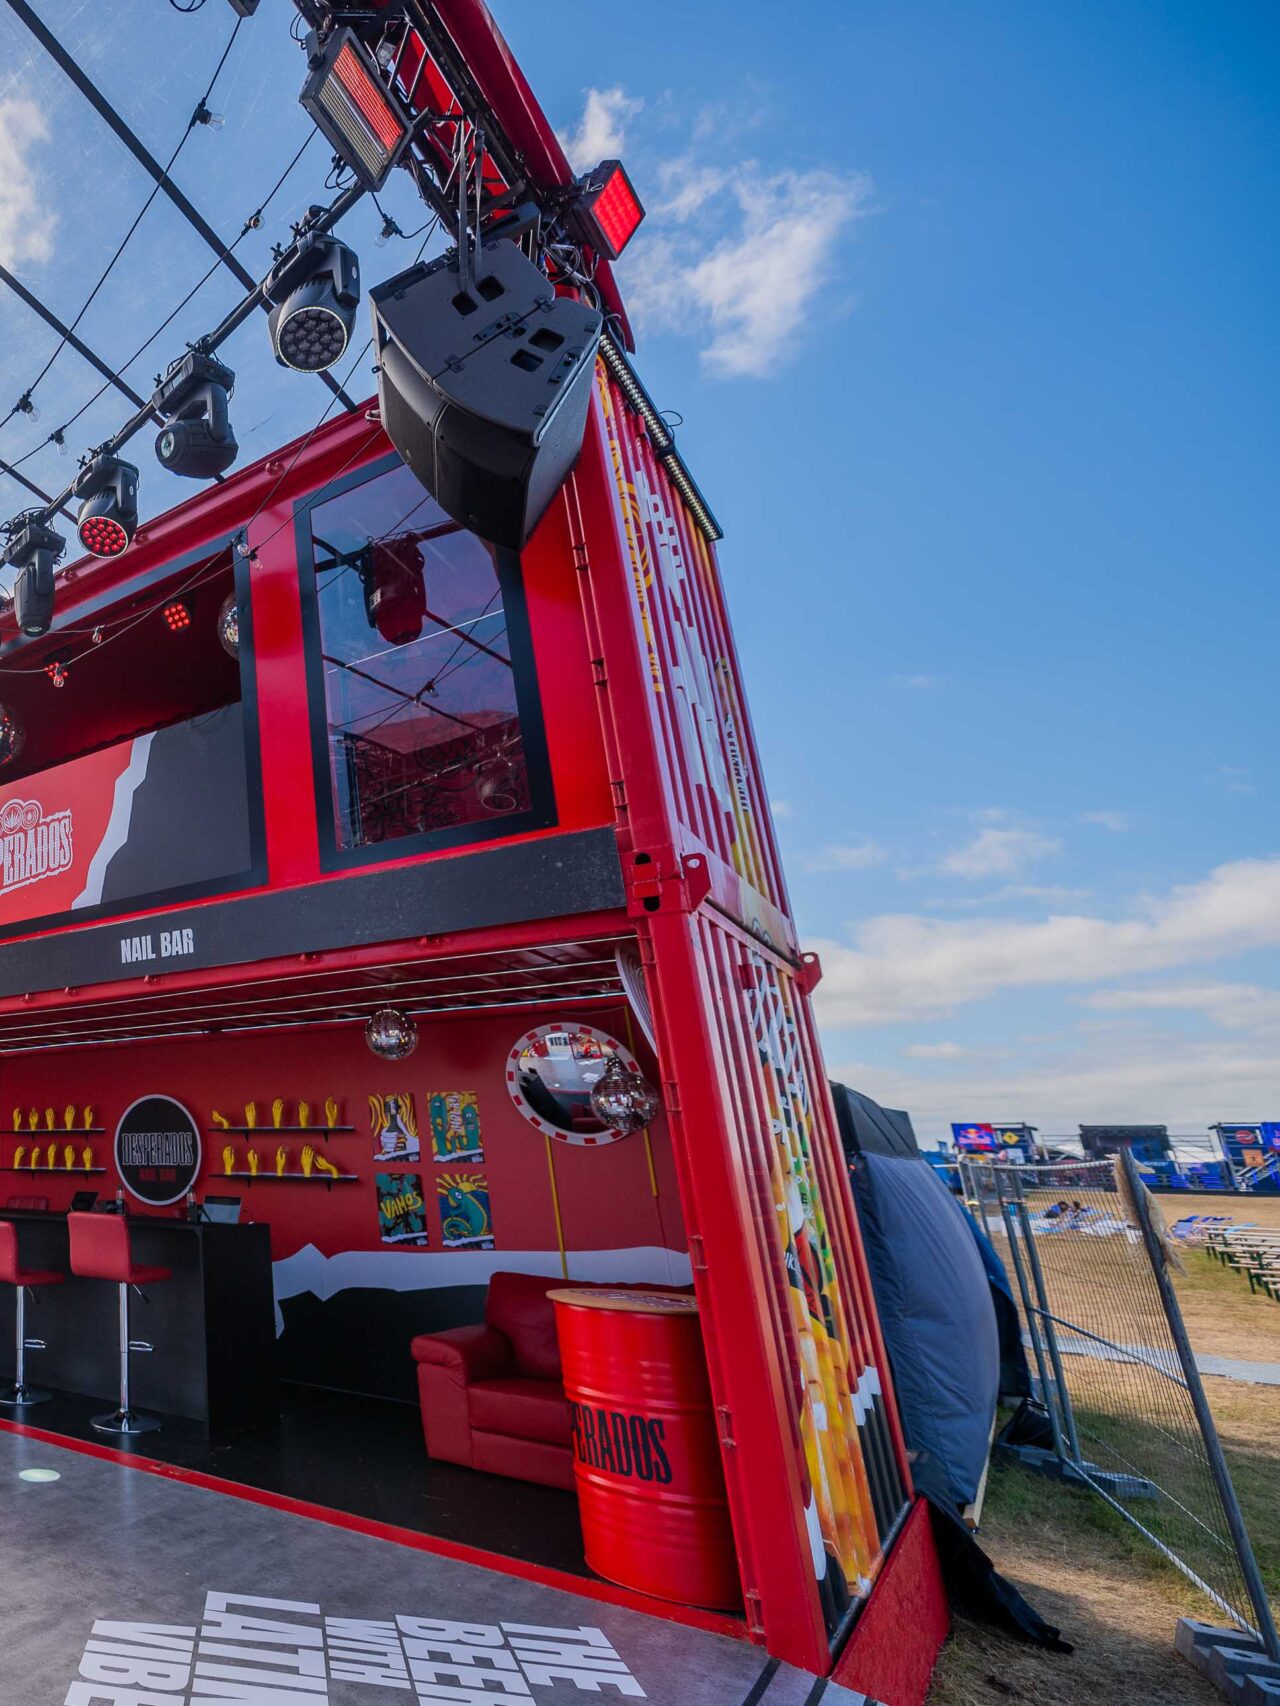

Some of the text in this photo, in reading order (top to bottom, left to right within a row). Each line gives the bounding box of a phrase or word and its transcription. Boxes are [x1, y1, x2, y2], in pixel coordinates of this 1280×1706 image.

[120, 928, 195, 964] NAIL BAR
[122, 1132, 194, 1166] DESPERADOS
[380, 1191, 422, 1219] VAMOS
[324, 1616, 413, 1690] WITH
[499, 1621, 648, 1698] THE
